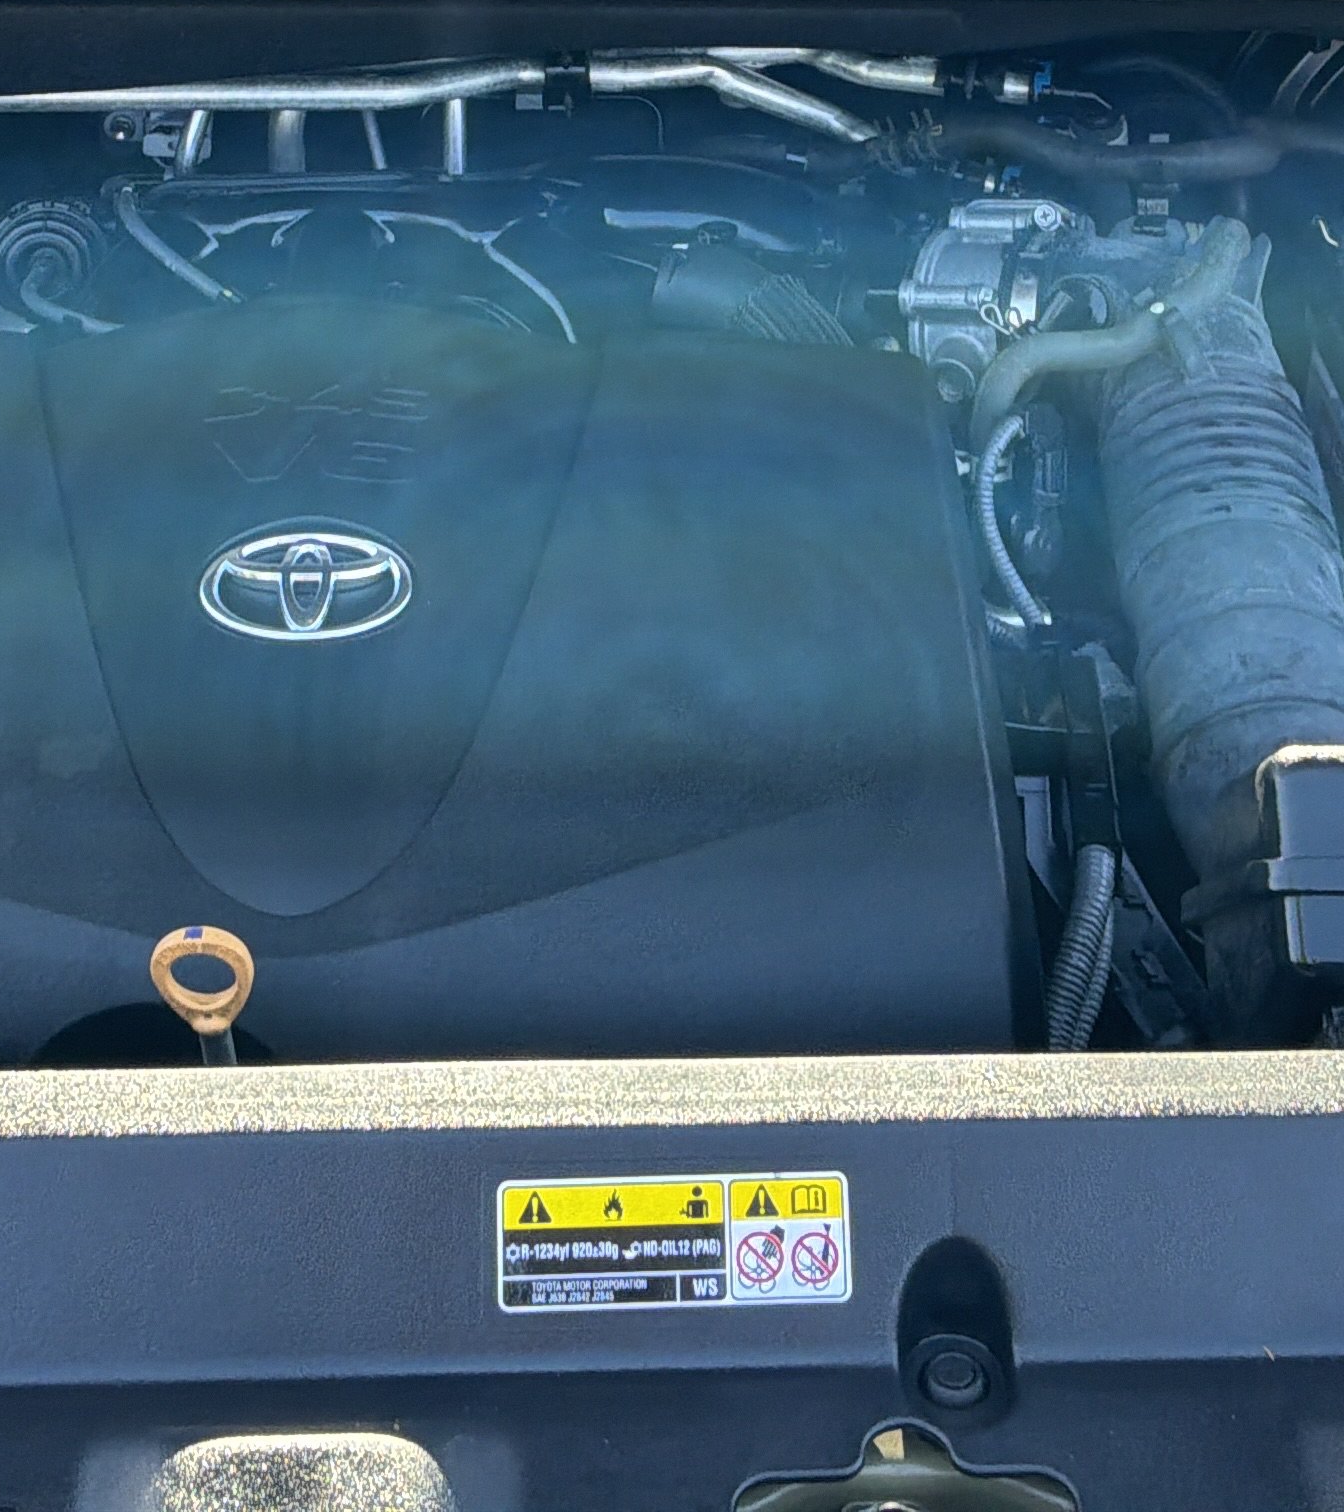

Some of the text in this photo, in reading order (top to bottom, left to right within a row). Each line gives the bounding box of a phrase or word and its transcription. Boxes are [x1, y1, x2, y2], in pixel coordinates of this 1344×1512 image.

[521, 1241, 570, 1261] R-1234yf
[643, 1239, 690, 1257] ND-OIL12
[692, 1238, 721, 1258] (PAG)
[532, 1278, 648, 1292] TOYOTA MOTOR CORPORATION
[692, 1277, 719, 1297] WS
